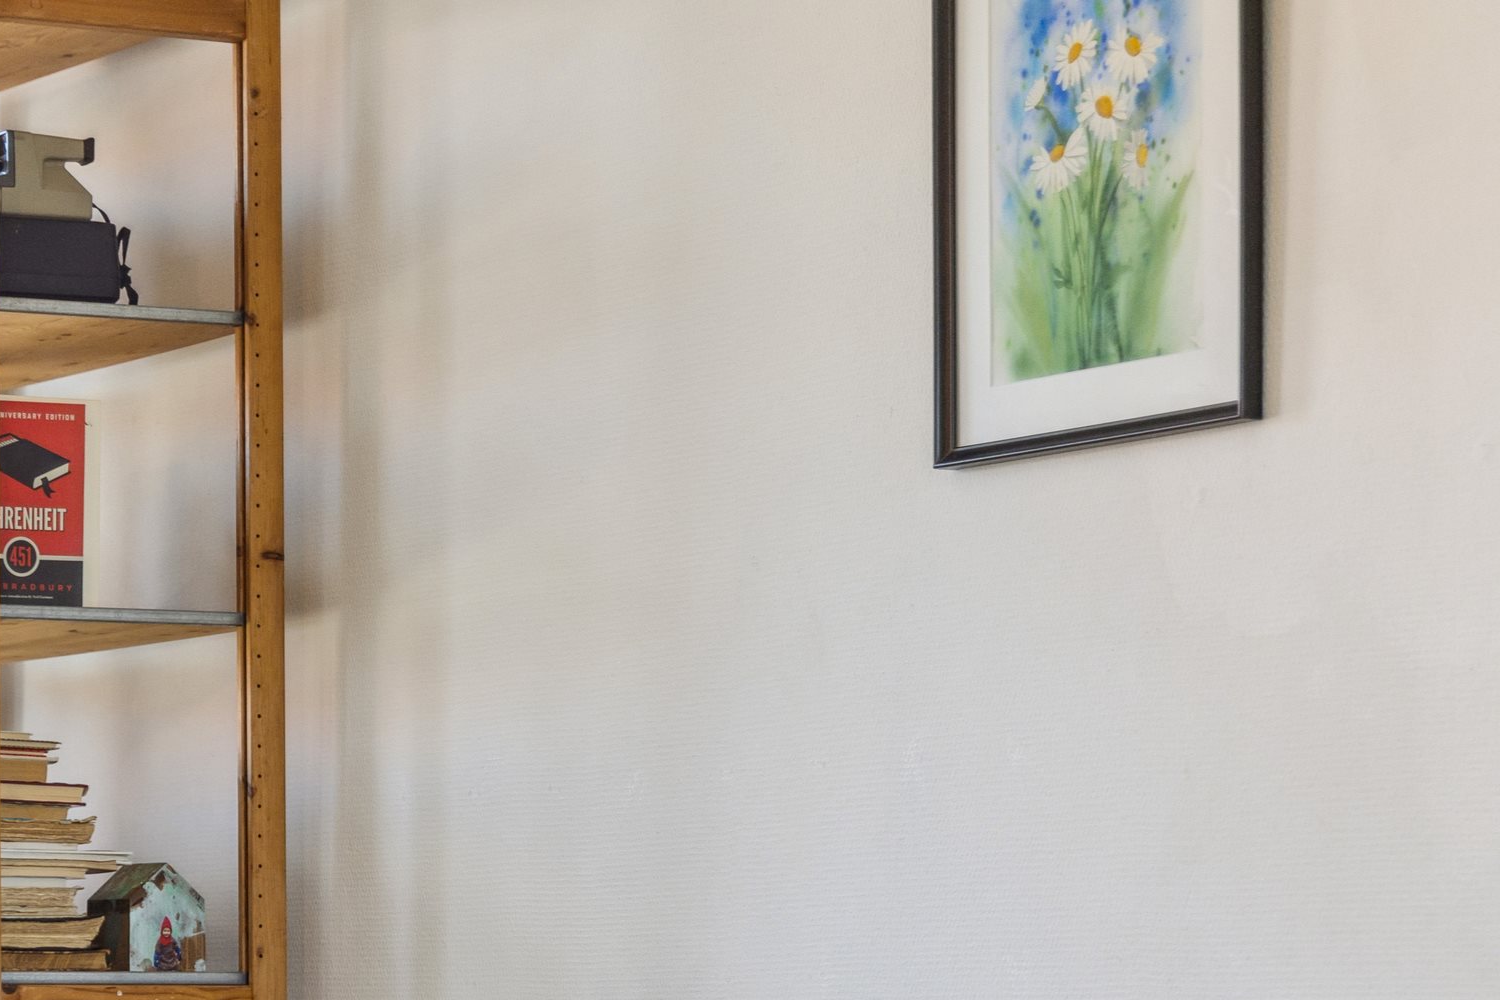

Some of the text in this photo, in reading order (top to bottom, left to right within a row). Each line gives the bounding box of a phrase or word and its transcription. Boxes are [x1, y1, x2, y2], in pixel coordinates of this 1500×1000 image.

[45, 413, 75, 421] EDITION
[10, 545, 32, 567] 451
[2, 582, 73, 592] BRADBURY
